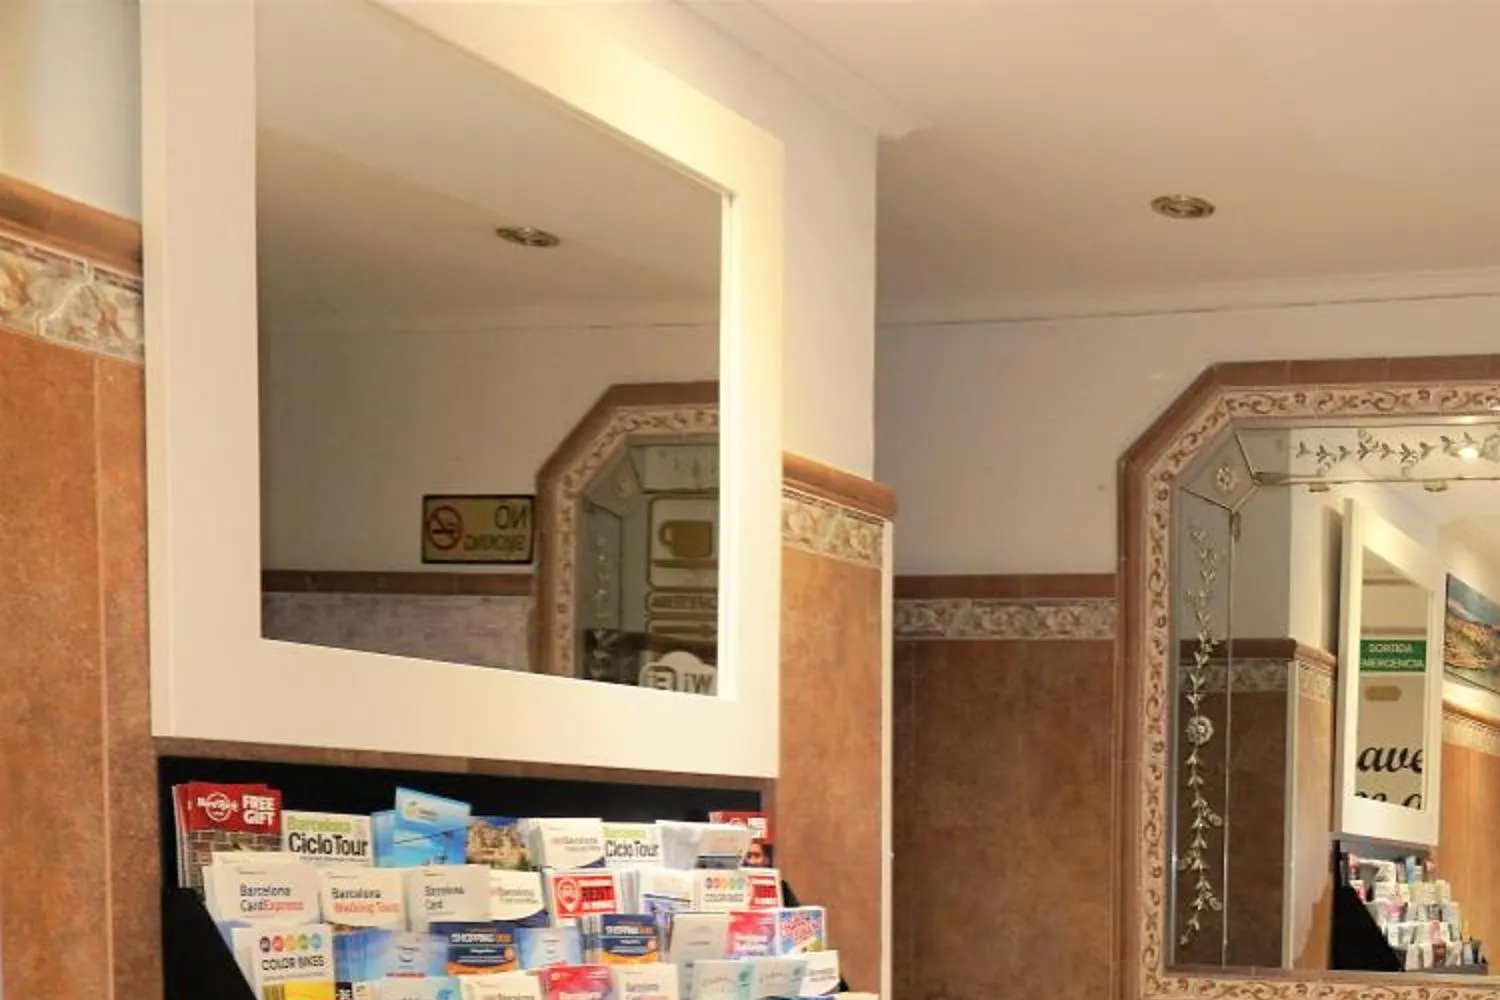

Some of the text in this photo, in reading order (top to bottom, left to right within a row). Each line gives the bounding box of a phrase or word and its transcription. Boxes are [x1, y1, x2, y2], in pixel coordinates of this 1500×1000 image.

[241, 794, 275, 811] FREE
[243, 810, 276, 827] GIFT
[288, 831, 369, 857] CicloTour
